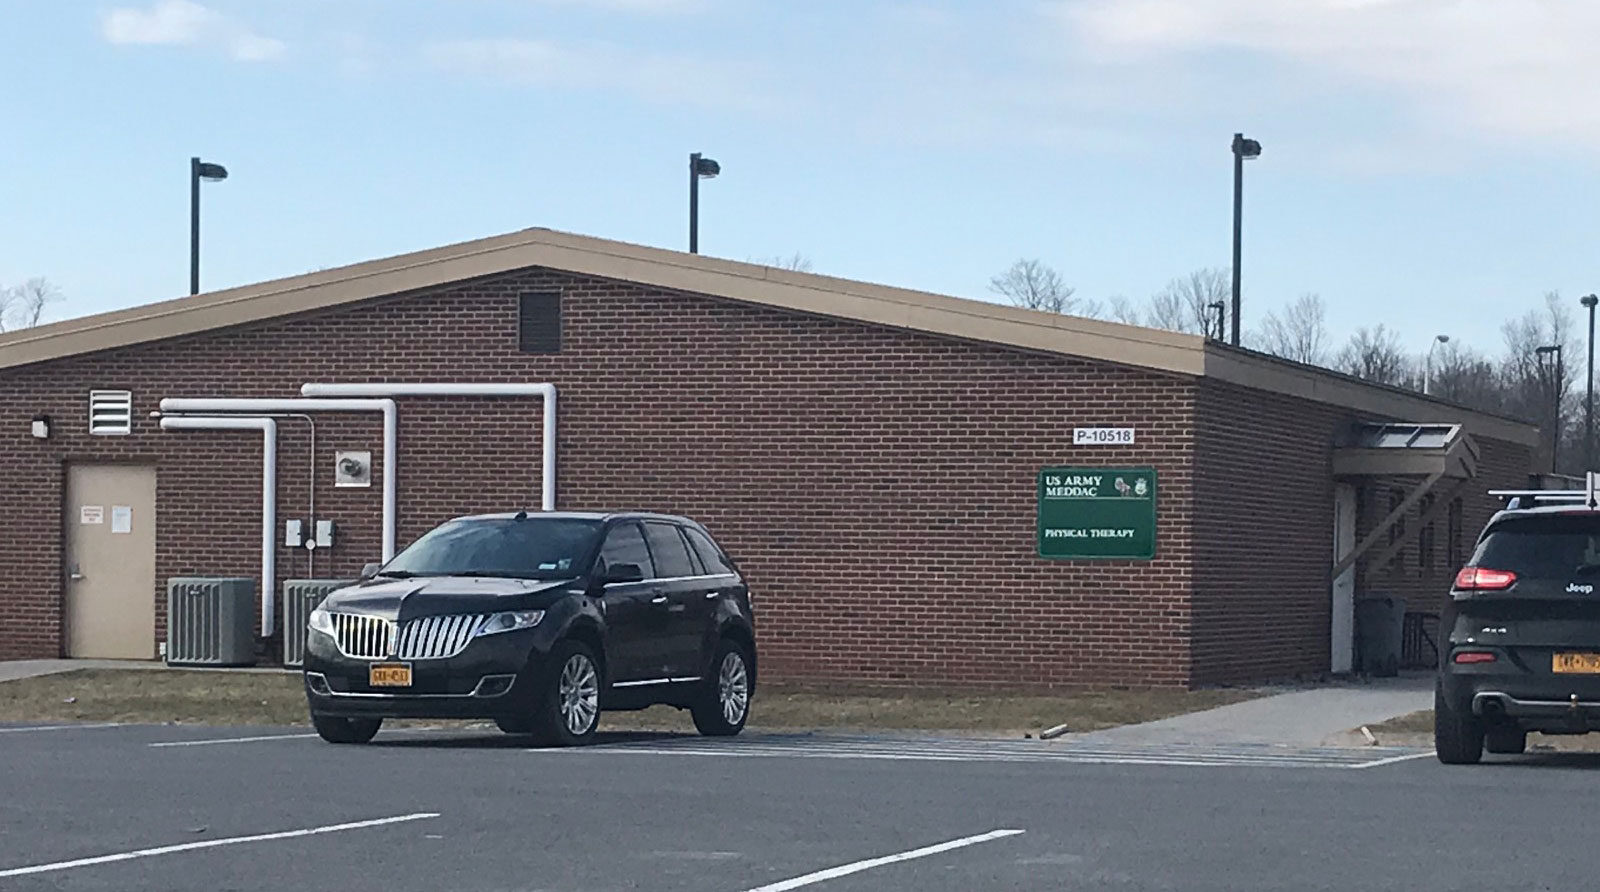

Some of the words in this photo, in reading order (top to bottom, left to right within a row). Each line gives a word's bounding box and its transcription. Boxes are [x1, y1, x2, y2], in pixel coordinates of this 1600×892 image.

[1077, 430, 1131, 442] P-10518
[1045, 476, 1061, 486] US
[1064, 476, 1103, 486] ARMY
[1045, 486, 1098, 497] MEDDAC
[1044, 529, 1088, 538] PHYSICAL
[1090, 529, 1135, 538] THERAPY
[1565, 582, 1594, 594] Jeep
